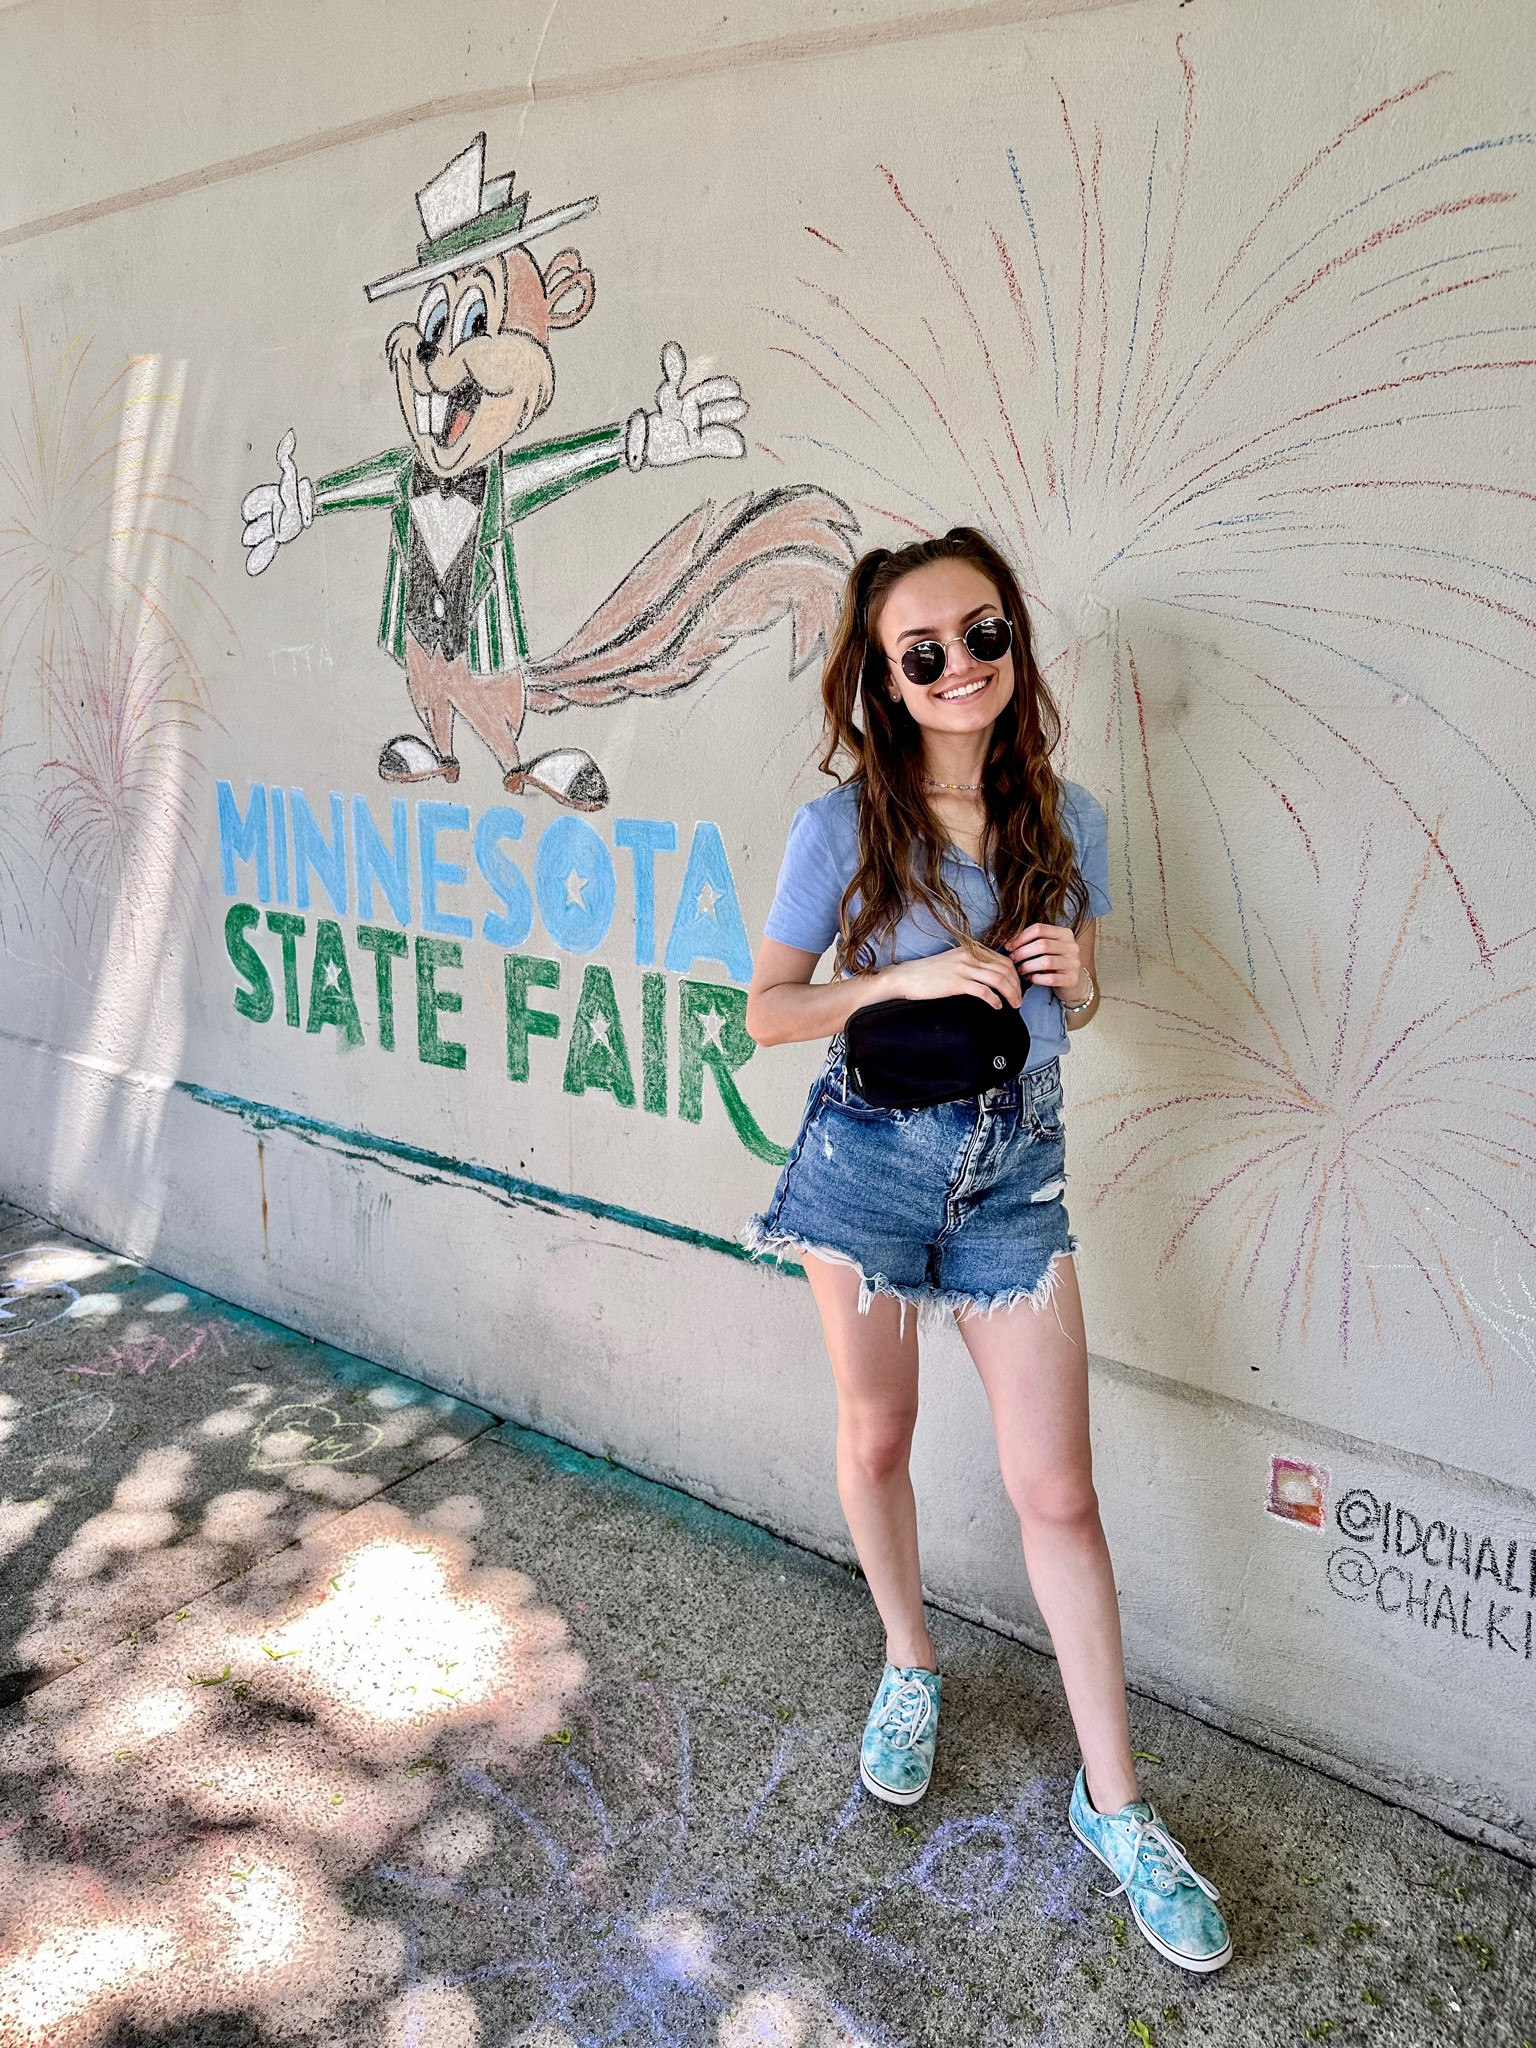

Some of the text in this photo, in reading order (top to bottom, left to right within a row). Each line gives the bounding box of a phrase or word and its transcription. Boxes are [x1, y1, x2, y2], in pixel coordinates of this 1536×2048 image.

[216, 780, 755, 984] MINNESOTA
[224, 902, 790, 1166] STATE FAIR
